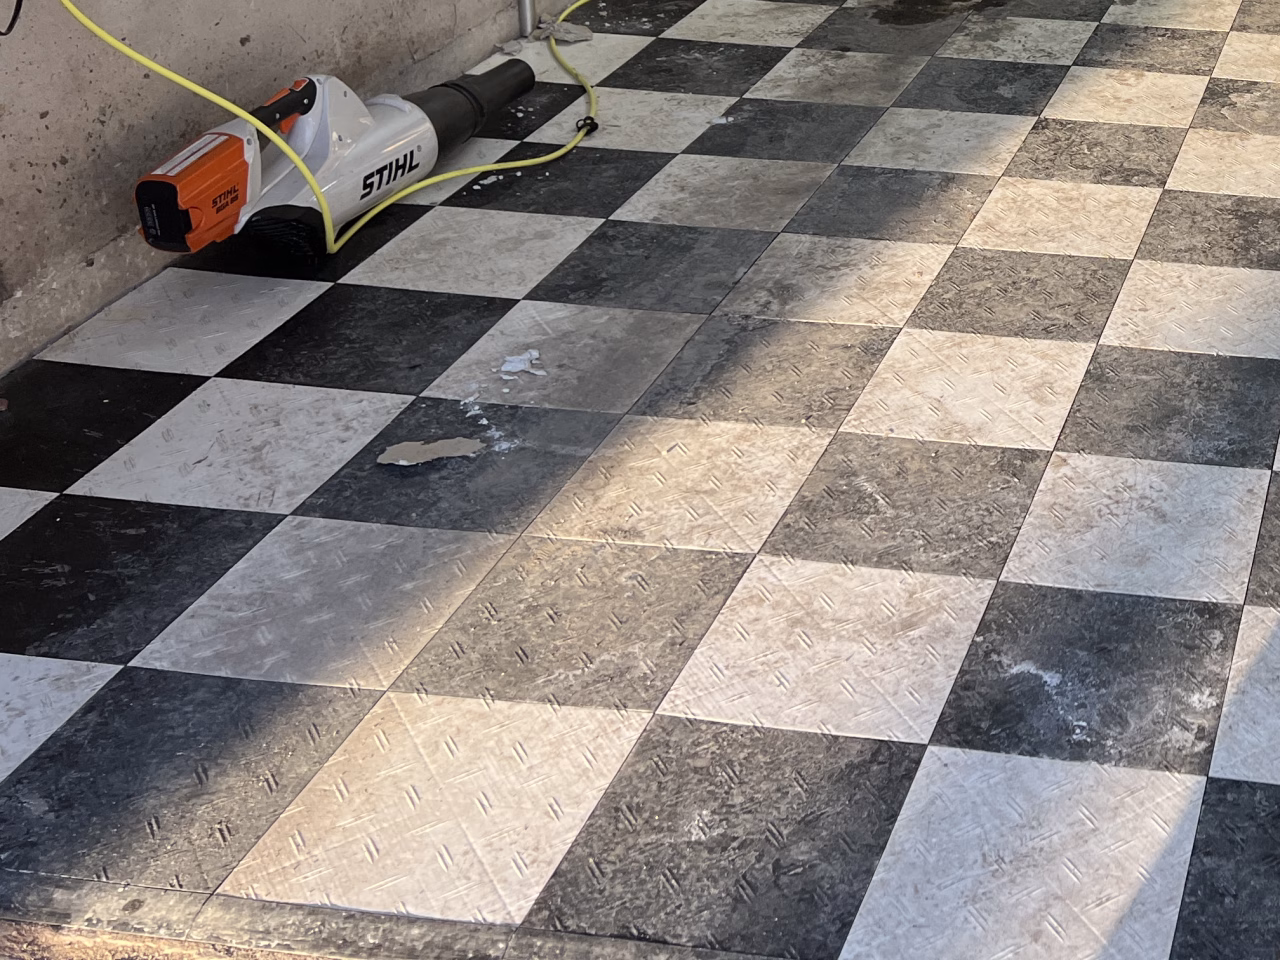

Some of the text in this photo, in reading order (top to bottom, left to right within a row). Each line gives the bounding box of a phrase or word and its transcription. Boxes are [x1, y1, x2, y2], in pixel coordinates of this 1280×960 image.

[360, 149, 420, 201] STIHL
[211, 185, 239, 209] STIHL
[215, 201, 230, 215] BGA
